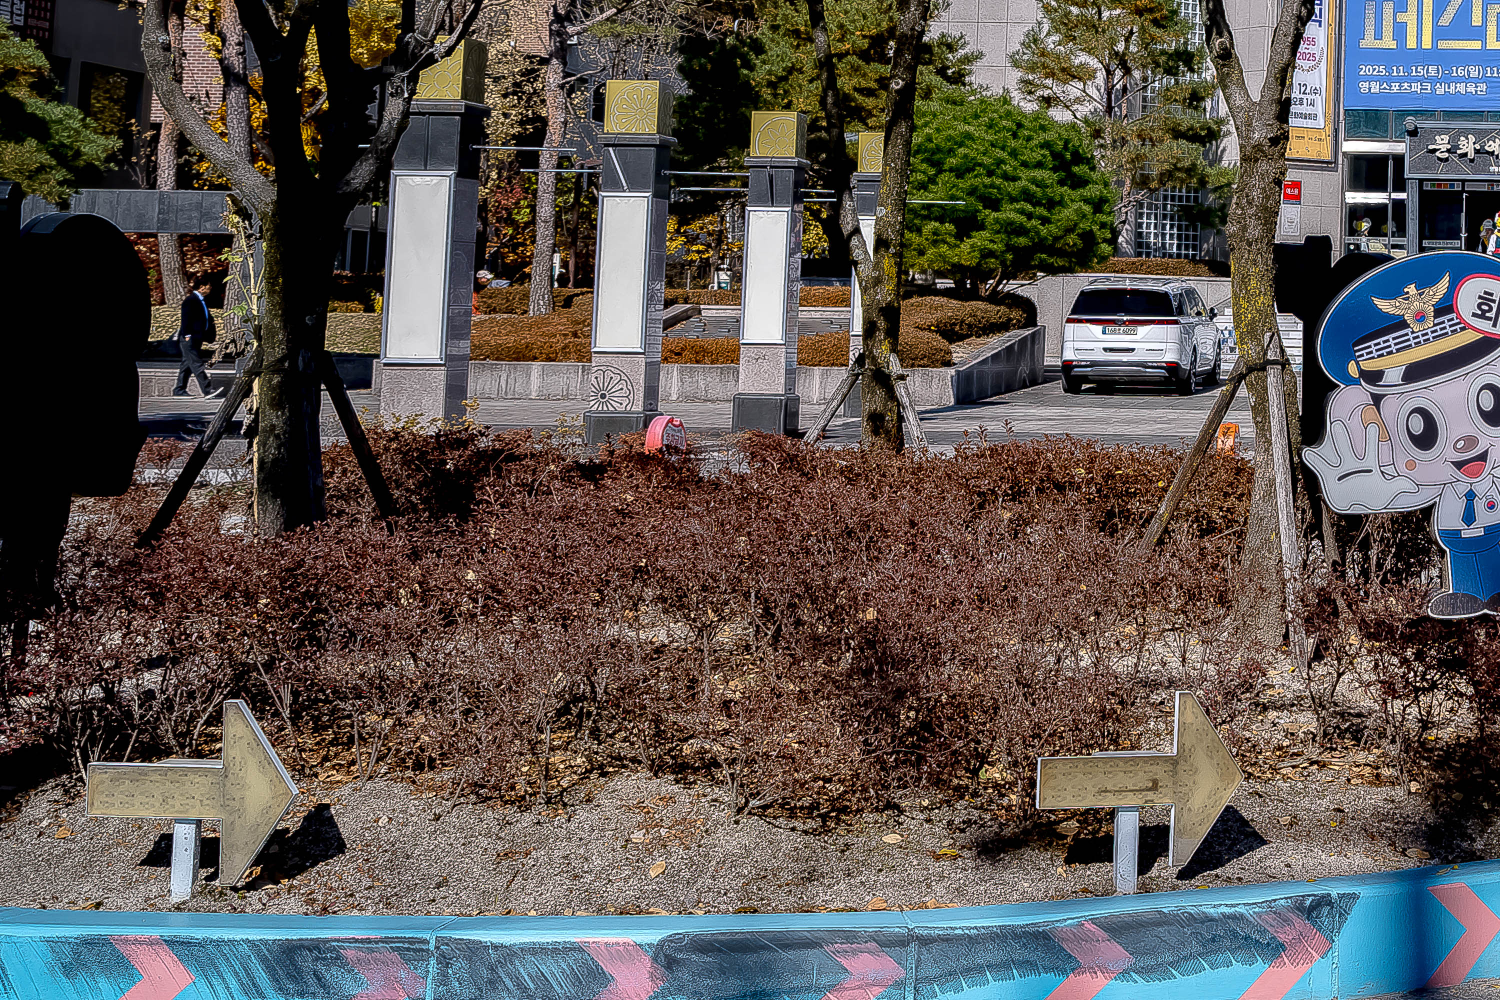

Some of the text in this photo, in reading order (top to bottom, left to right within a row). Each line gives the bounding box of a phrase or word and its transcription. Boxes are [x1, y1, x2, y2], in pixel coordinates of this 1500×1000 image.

[1297, 51, 1317, 62] 2025
[1359, 65, 1389, 76] 2025.
[1391, 66, 1408, 76] 11.
[1410, 65, 1443, 78] 15(토)
[1451, 66, 1484, 78] 16(일)
[1358, 81, 1488, 95] 영월스포츠파크 실내체육관
